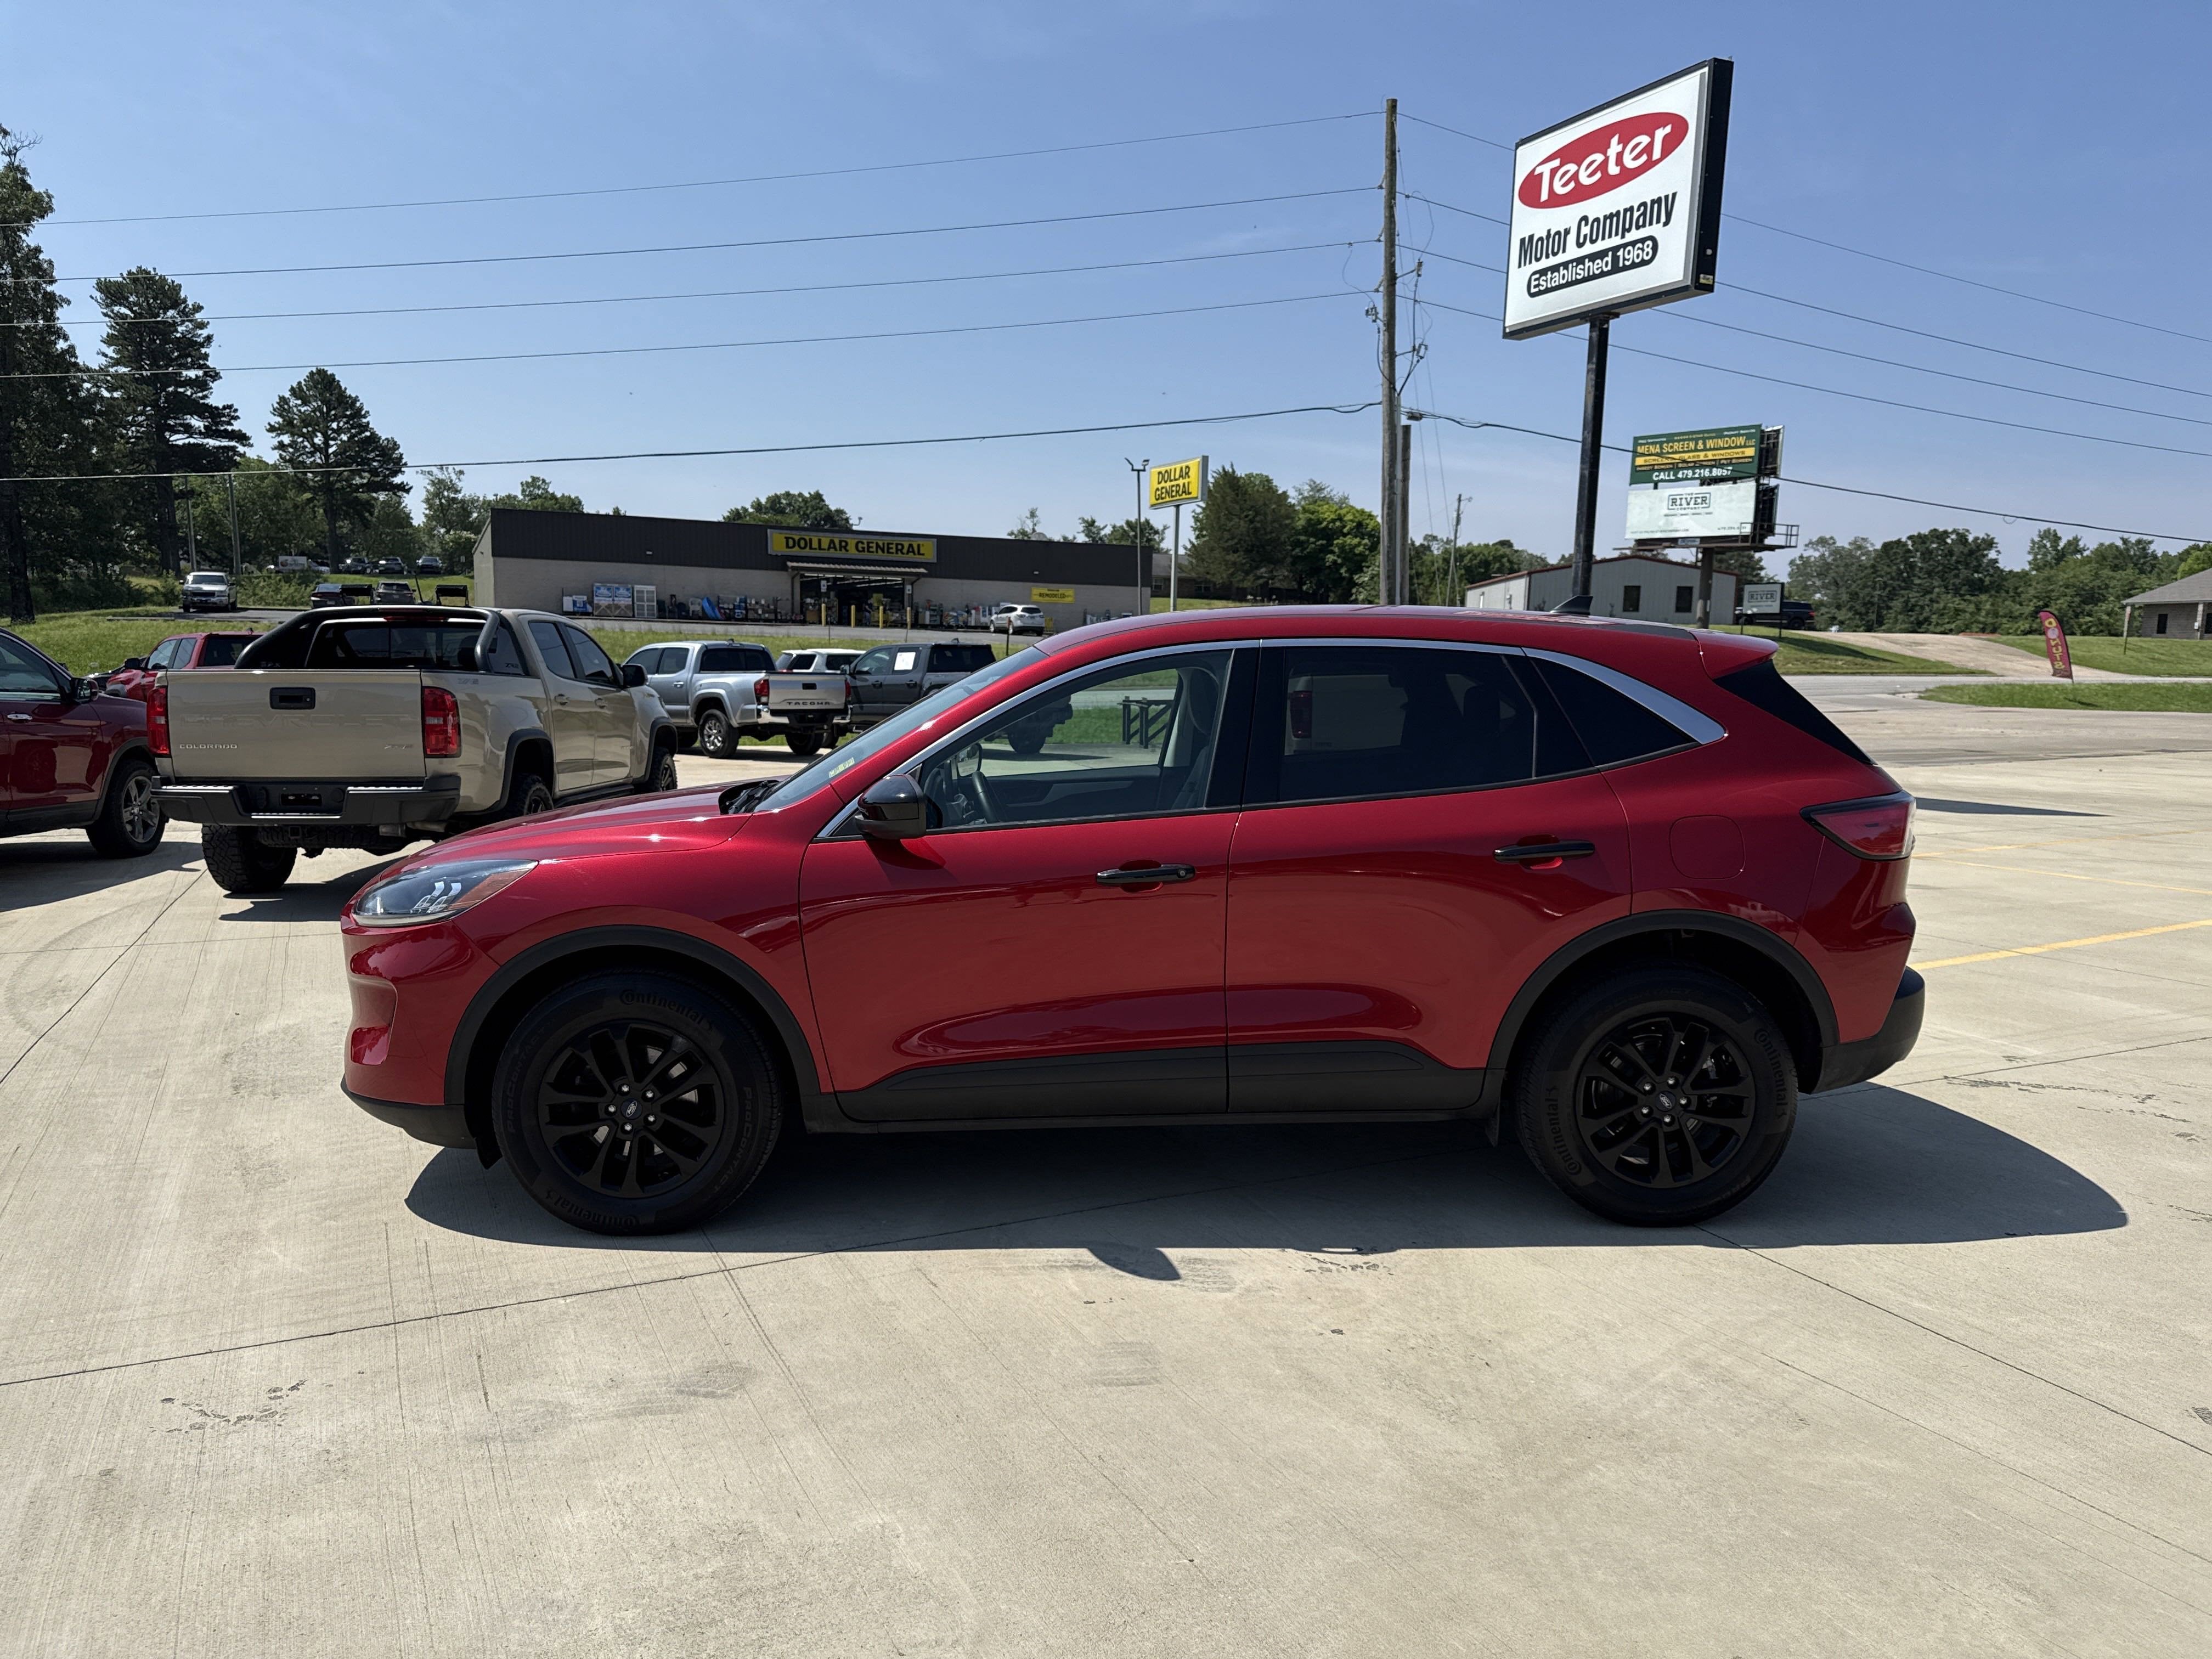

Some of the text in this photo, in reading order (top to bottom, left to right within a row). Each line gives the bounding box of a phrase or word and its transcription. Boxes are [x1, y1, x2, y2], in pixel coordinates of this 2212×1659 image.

[1534, 124, 1672, 203] Teeter
[1517, 191, 1678, 269] Motor Company
[1530, 242, 1654, 293] Established 1968
[1637, 444, 1661, 454] MENA
[1662, 441, 1695, 453] SCREEN
[1697, 439, 1703, 449] &
[1706, 436, 1746, 449] WINDOW
[1157, 465, 1190, 485] DOLLAR
[1652, 471, 1675, 481] CALL
[1154, 481, 1192, 501] GENERAL
[1671, 496, 1708, 507] RIVER
[784, 536, 925, 556] DOLLAR GENERAL
[619, 989, 705, 1025] Continental
[1754, 1028, 1788, 1107] Continental
[1545, 1098, 1582, 1176] Continental
